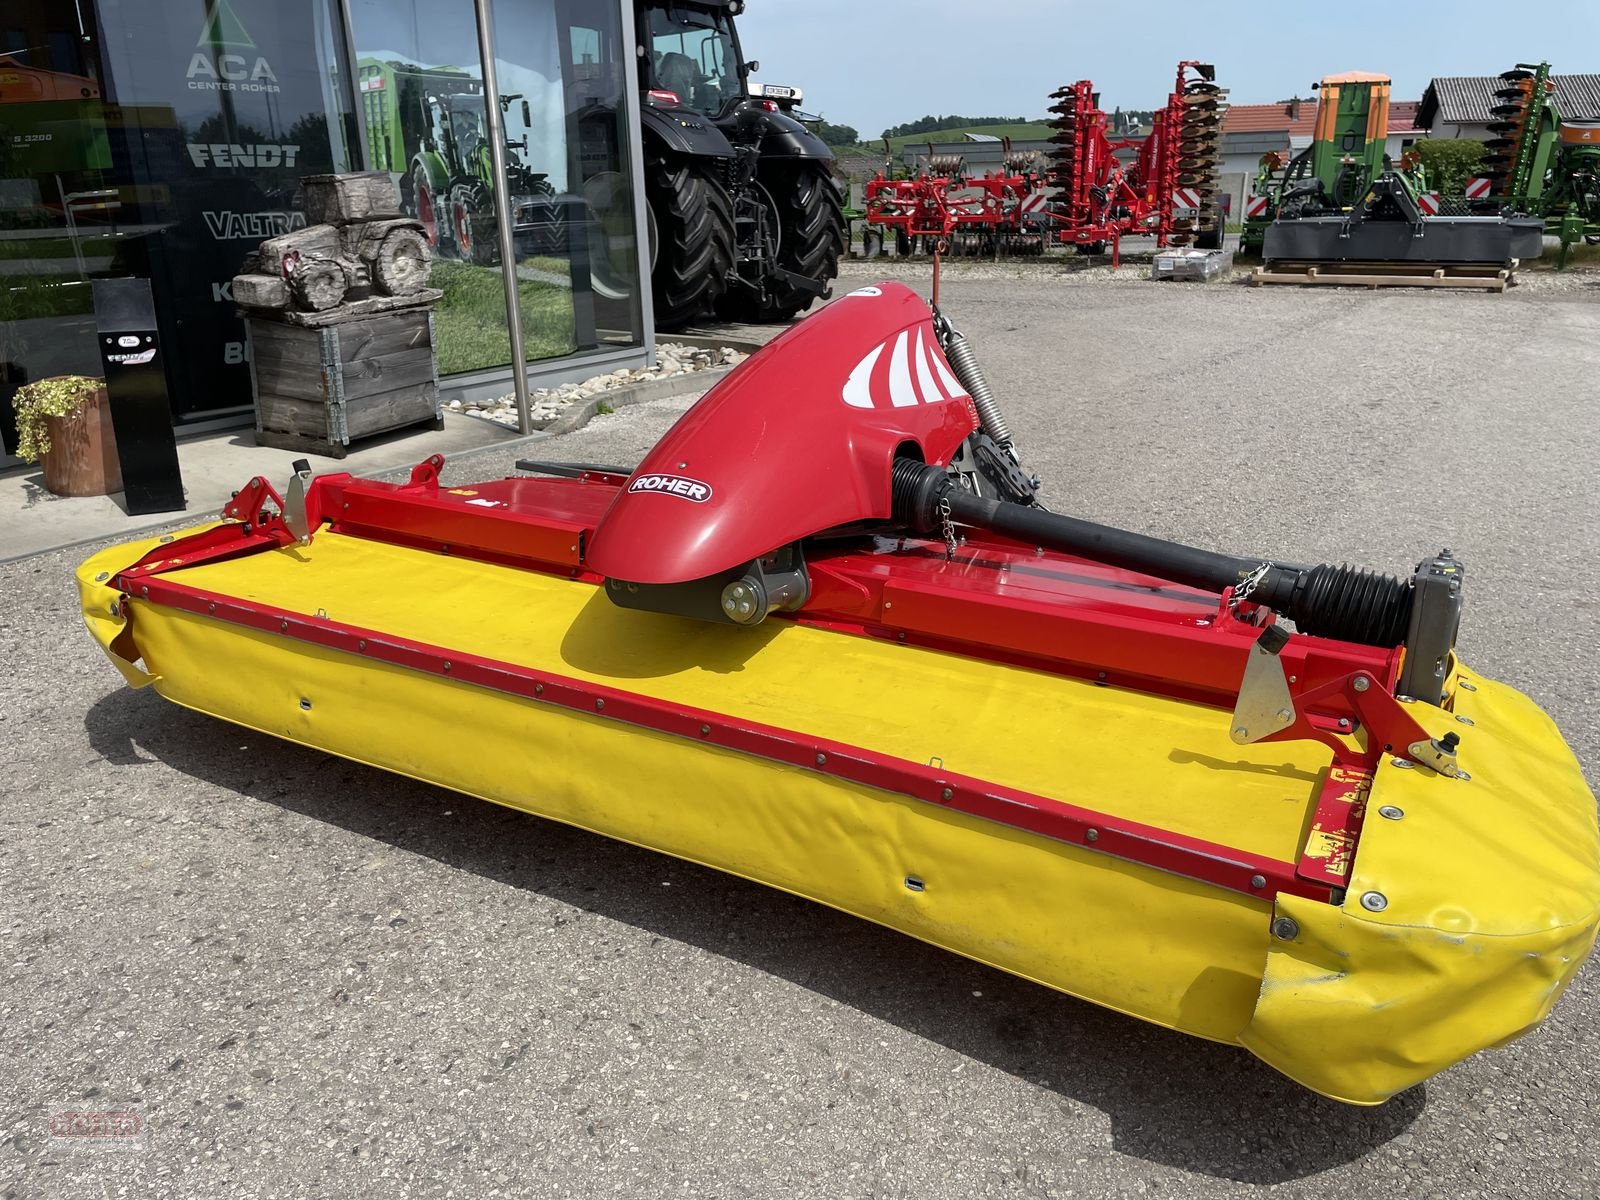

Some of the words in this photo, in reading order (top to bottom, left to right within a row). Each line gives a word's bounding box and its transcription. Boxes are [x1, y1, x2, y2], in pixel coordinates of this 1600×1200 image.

[186, 53, 278, 82] ACA
[187, 81, 237, 91] CENTER
[240, 83, 281, 93] ROHER
[25, 134, 52, 142] 3200
[185, 143, 300, 168] FENDT
[202, 211, 307, 240] VALTRA
[631, 476, 707, 500] ROHER
